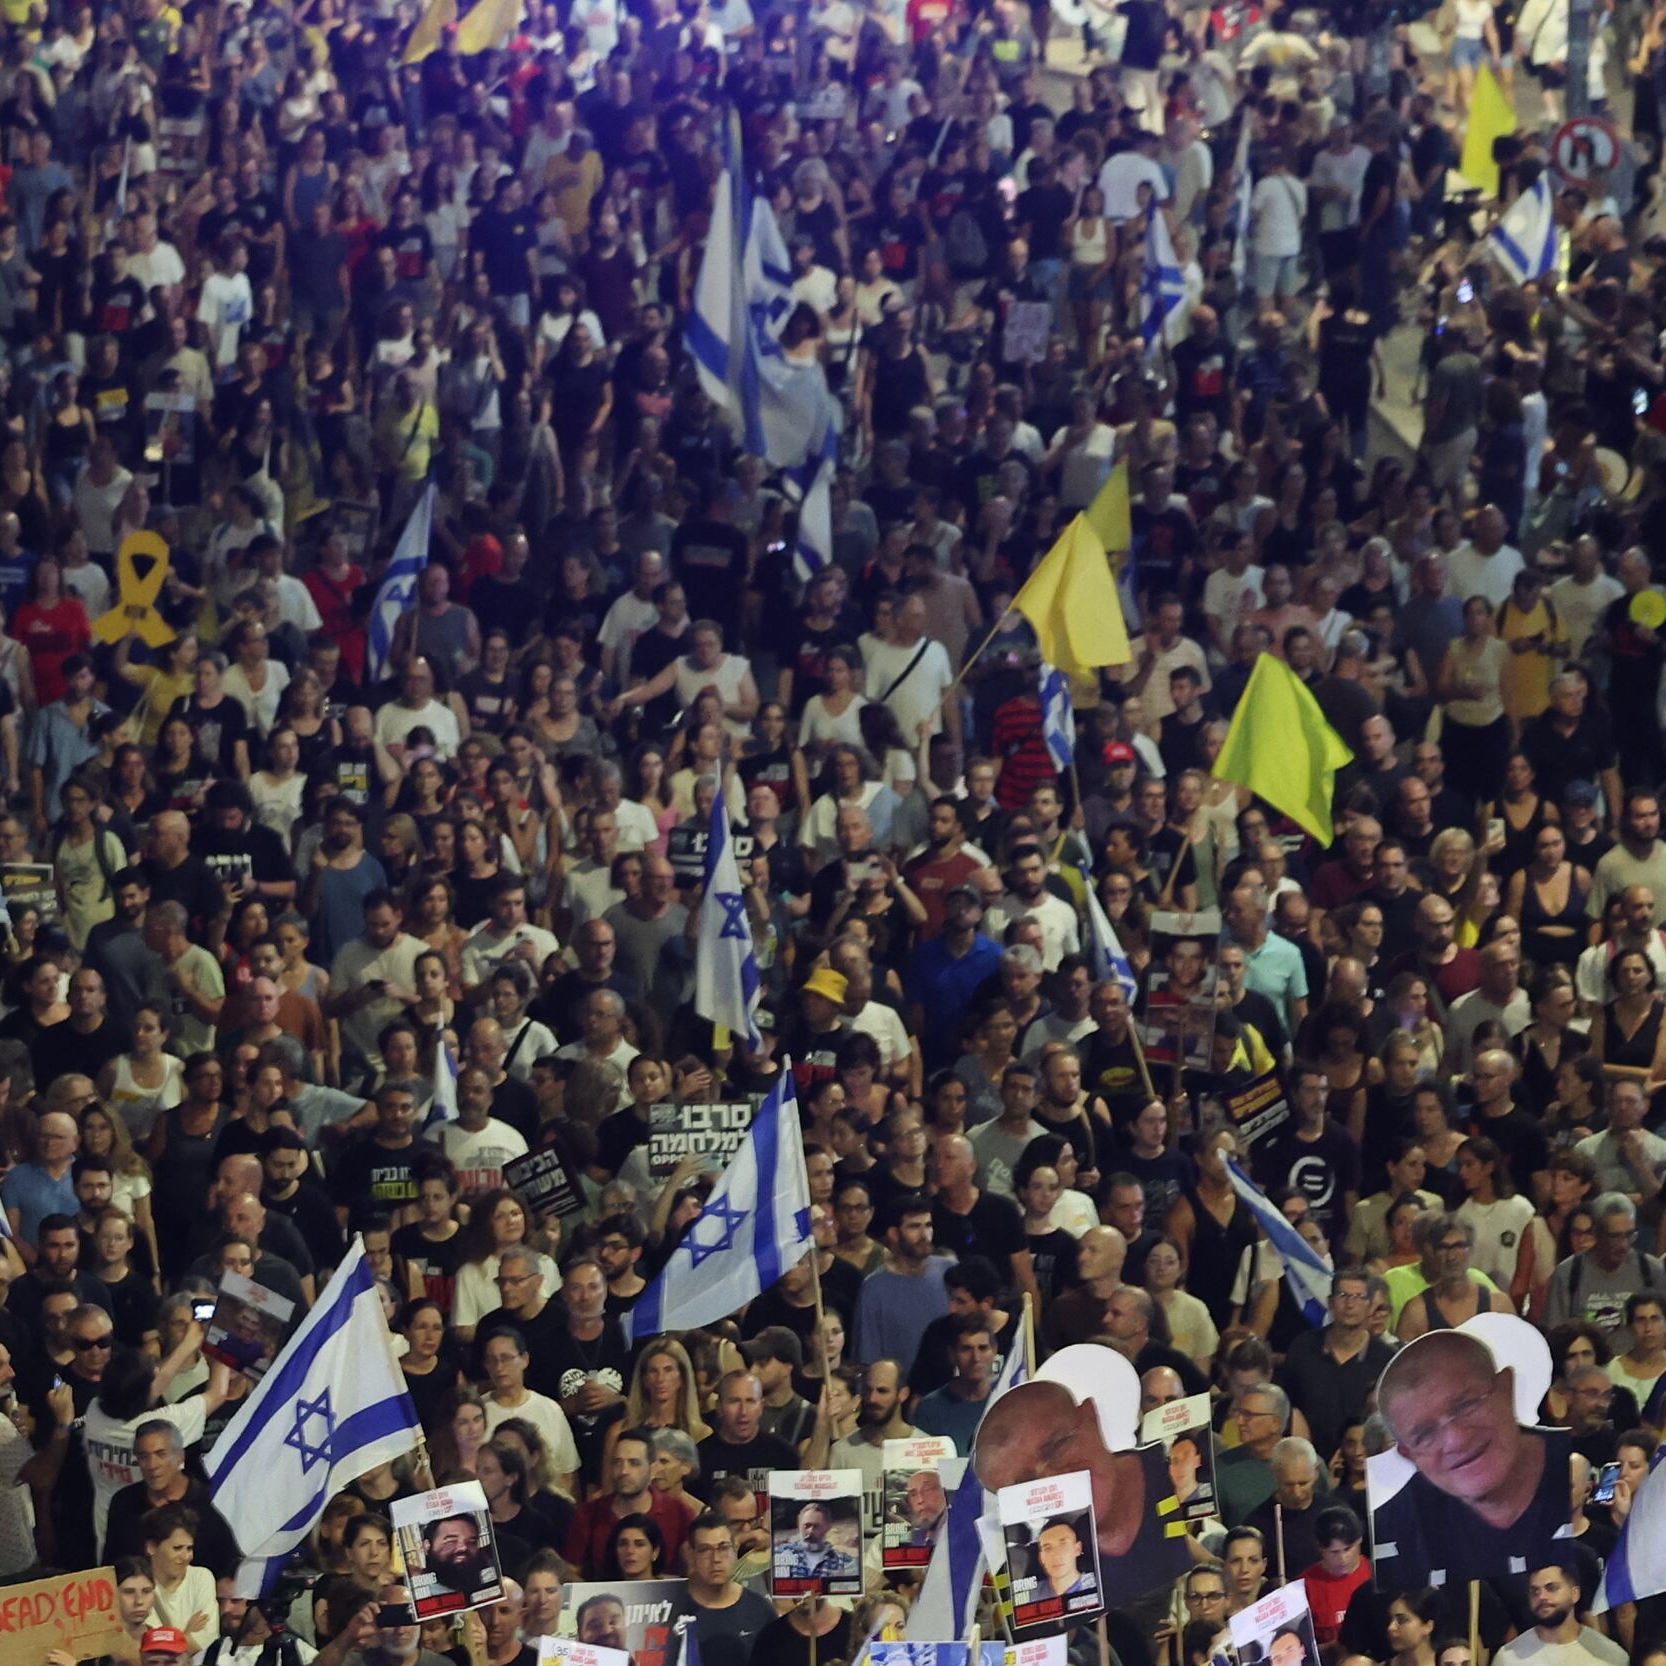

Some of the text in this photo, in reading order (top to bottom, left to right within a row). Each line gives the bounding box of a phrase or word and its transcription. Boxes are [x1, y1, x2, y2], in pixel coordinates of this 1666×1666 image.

[682, 1104, 752, 1130] סרבו
[651, 1131, 757, 1156] למלחמה
[1013, 1576, 1038, 1592] BRING
[61, 1579, 115, 1620] END
